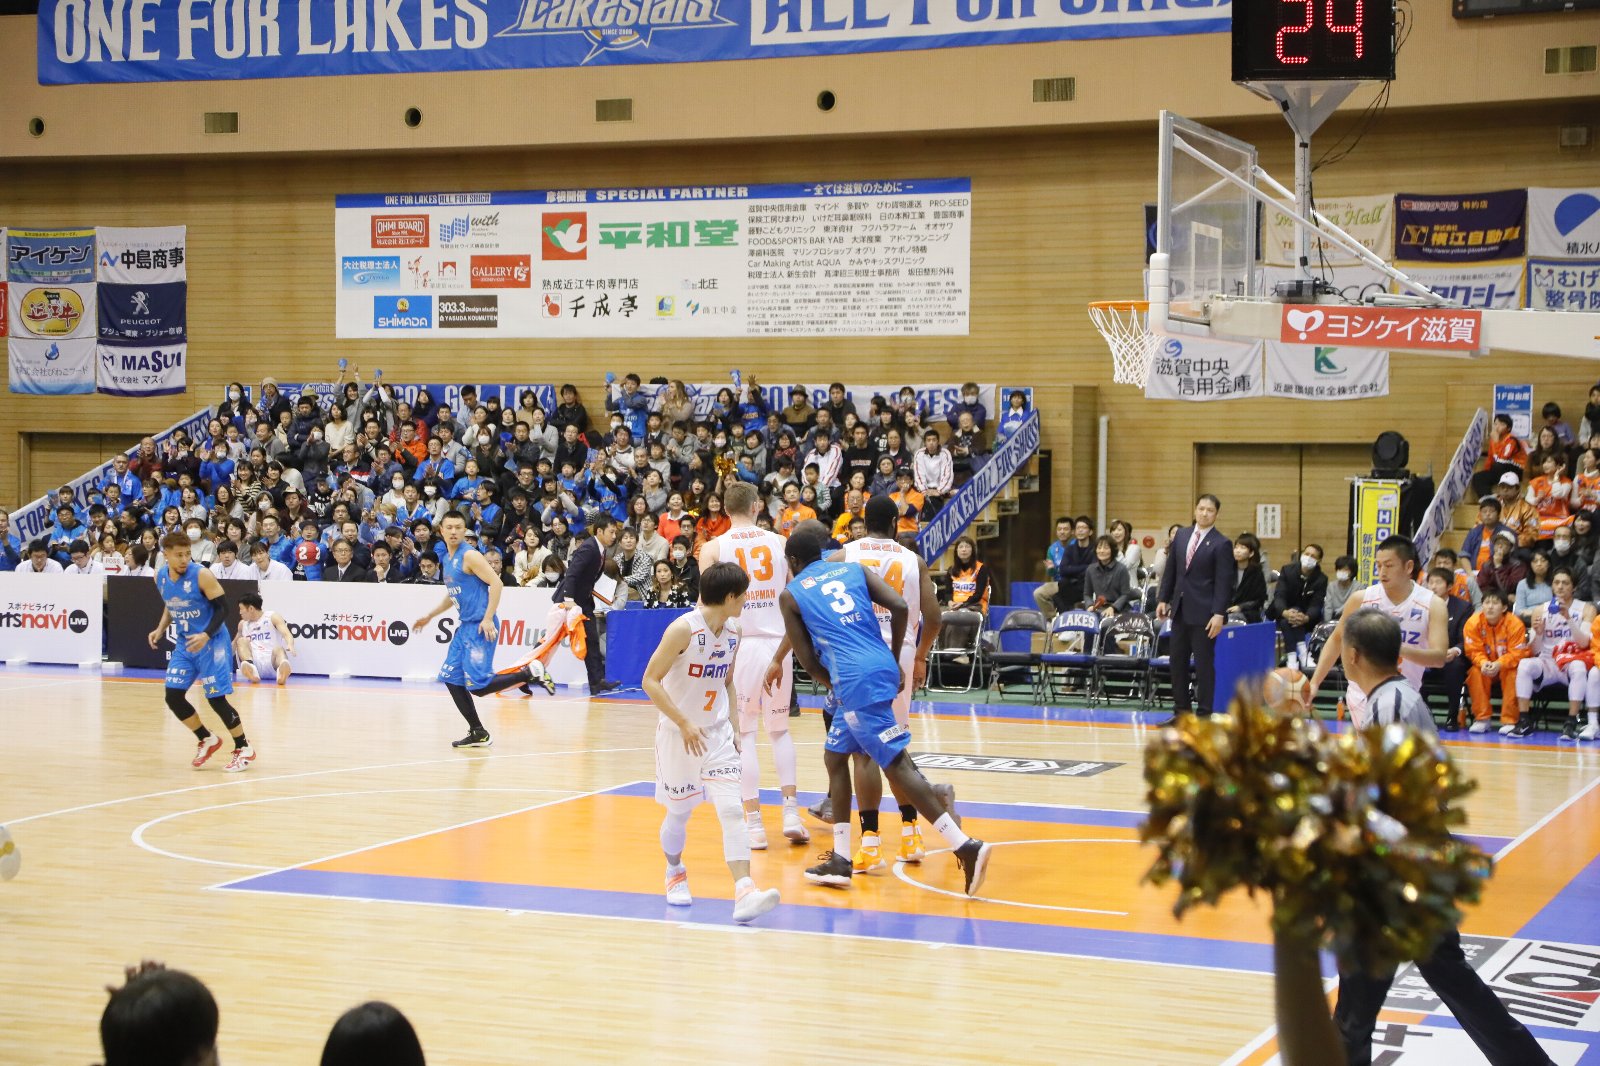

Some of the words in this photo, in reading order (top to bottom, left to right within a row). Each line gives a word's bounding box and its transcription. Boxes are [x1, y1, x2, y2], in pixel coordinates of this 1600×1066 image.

[54, 0, 160, 63] ONE
[176, 0, 281, 60] FOR
[297, 0, 488, 56] LAKES
[1275, 0, 1362, 63] 24
[385, 195, 399, 205] ONE
[400, 195, 413, 204] FOR
[414, 195, 438, 204] LAKES
[439, 194, 452, 203] ALL
[469, 193, 489, 203] SHIGA
[596, 189, 664, 202] SPECIAL
[670, 187, 748, 200] PARTNER
[929, 199, 969, 207] PRO-SEED
[471, 211, 500, 226] with
[1344, 201, 1387, 225] Hall
[377, 221, 396, 234] OHMI
[398, 221, 423, 234] BOARD
[599, 218, 740, 250] 平和堂
[748, 237, 807, 246] FOOD&SPORTS
[810, 236, 825, 244] BAR
[828, 236, 844, 244] YAB
[10, 245, 92, 266] アイケン
[121, 246, 184, 270] 中島商事
[747, 260, 760, 268] Car
[763, 259, 791, 269] Making
[793, 258, 814, 267] Artist
[816, 258, 841, 267] AQUA
[472, 266, 512, 277] GALLERY
[542, 279, 639, 289] 熟成近江牛肉専門店
[27, 302, 80, 328] 近江牛
[439, 302, 465, 313] 303.3
[1326, 314, 1476, 344] ヨシケイ滋賀
[122, 349, 182, 373] MASUI
[1156, 358, 1230, 377] 滋賀中央
[1177, 374, 1252, 397] 信用金庫
[1273, 382, 1380, 397] 近畿環境保全株式会社
[735, 545, 774, 582] 13
[821, 580, 855, 614] 3
[8, 602, 55, 612] スポナビライブ
[70, 617, 88, 626] LIVE
[323, 613, 373, 624] スポナビライブ
[1059, 613, 1096, 629] LAKES
[390, 629, 408, 638] LIVE
[703, 690, 718, 711] 7
